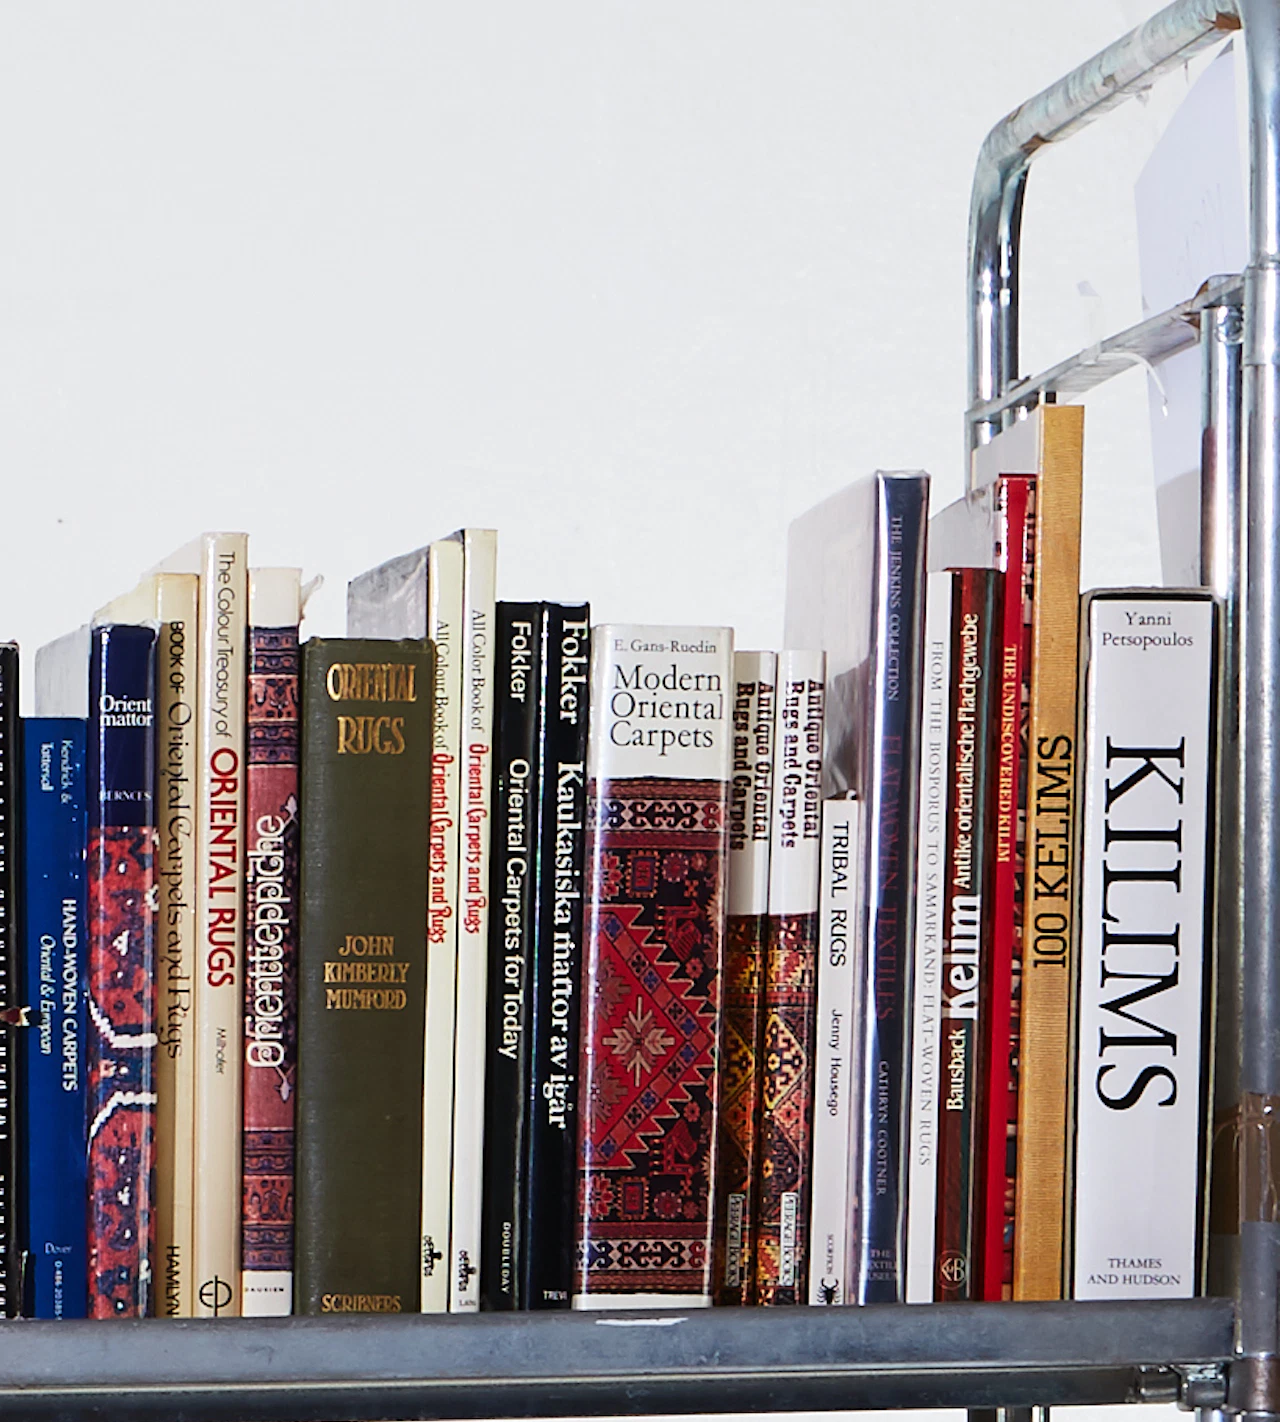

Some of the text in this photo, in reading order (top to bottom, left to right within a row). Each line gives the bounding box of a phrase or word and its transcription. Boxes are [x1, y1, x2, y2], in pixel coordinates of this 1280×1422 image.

[1123, 610, 1172, 627] Yanni
[1101, 632, 1195, 649] Petsopoulos
[206, 552, 240, 1075] The Colour Treasury of ORIENTAL RUGS Milhofer
[497, 621, 530, 1059] Fokker Oriental Carpets for Today
[1034, 735, 1072, 968] 100 KELIMS
[1093, 735, 1188, 1112] KILIMS
[338, 936, 395, 955] JOHN
[323, 963, 410, 983] KIMBERLY
[826, 820, 849, 1116] TRIBAL RUGS Jenny Housego
[61, 899, 77, 1090] HAND-WOVEN CARPETS
[324, 989, 407, 1011] MUMFORD
[1107, 1257, 1162, 1270] THAMES
[1087, 1274, 1180, 1286] AND HUDSON
